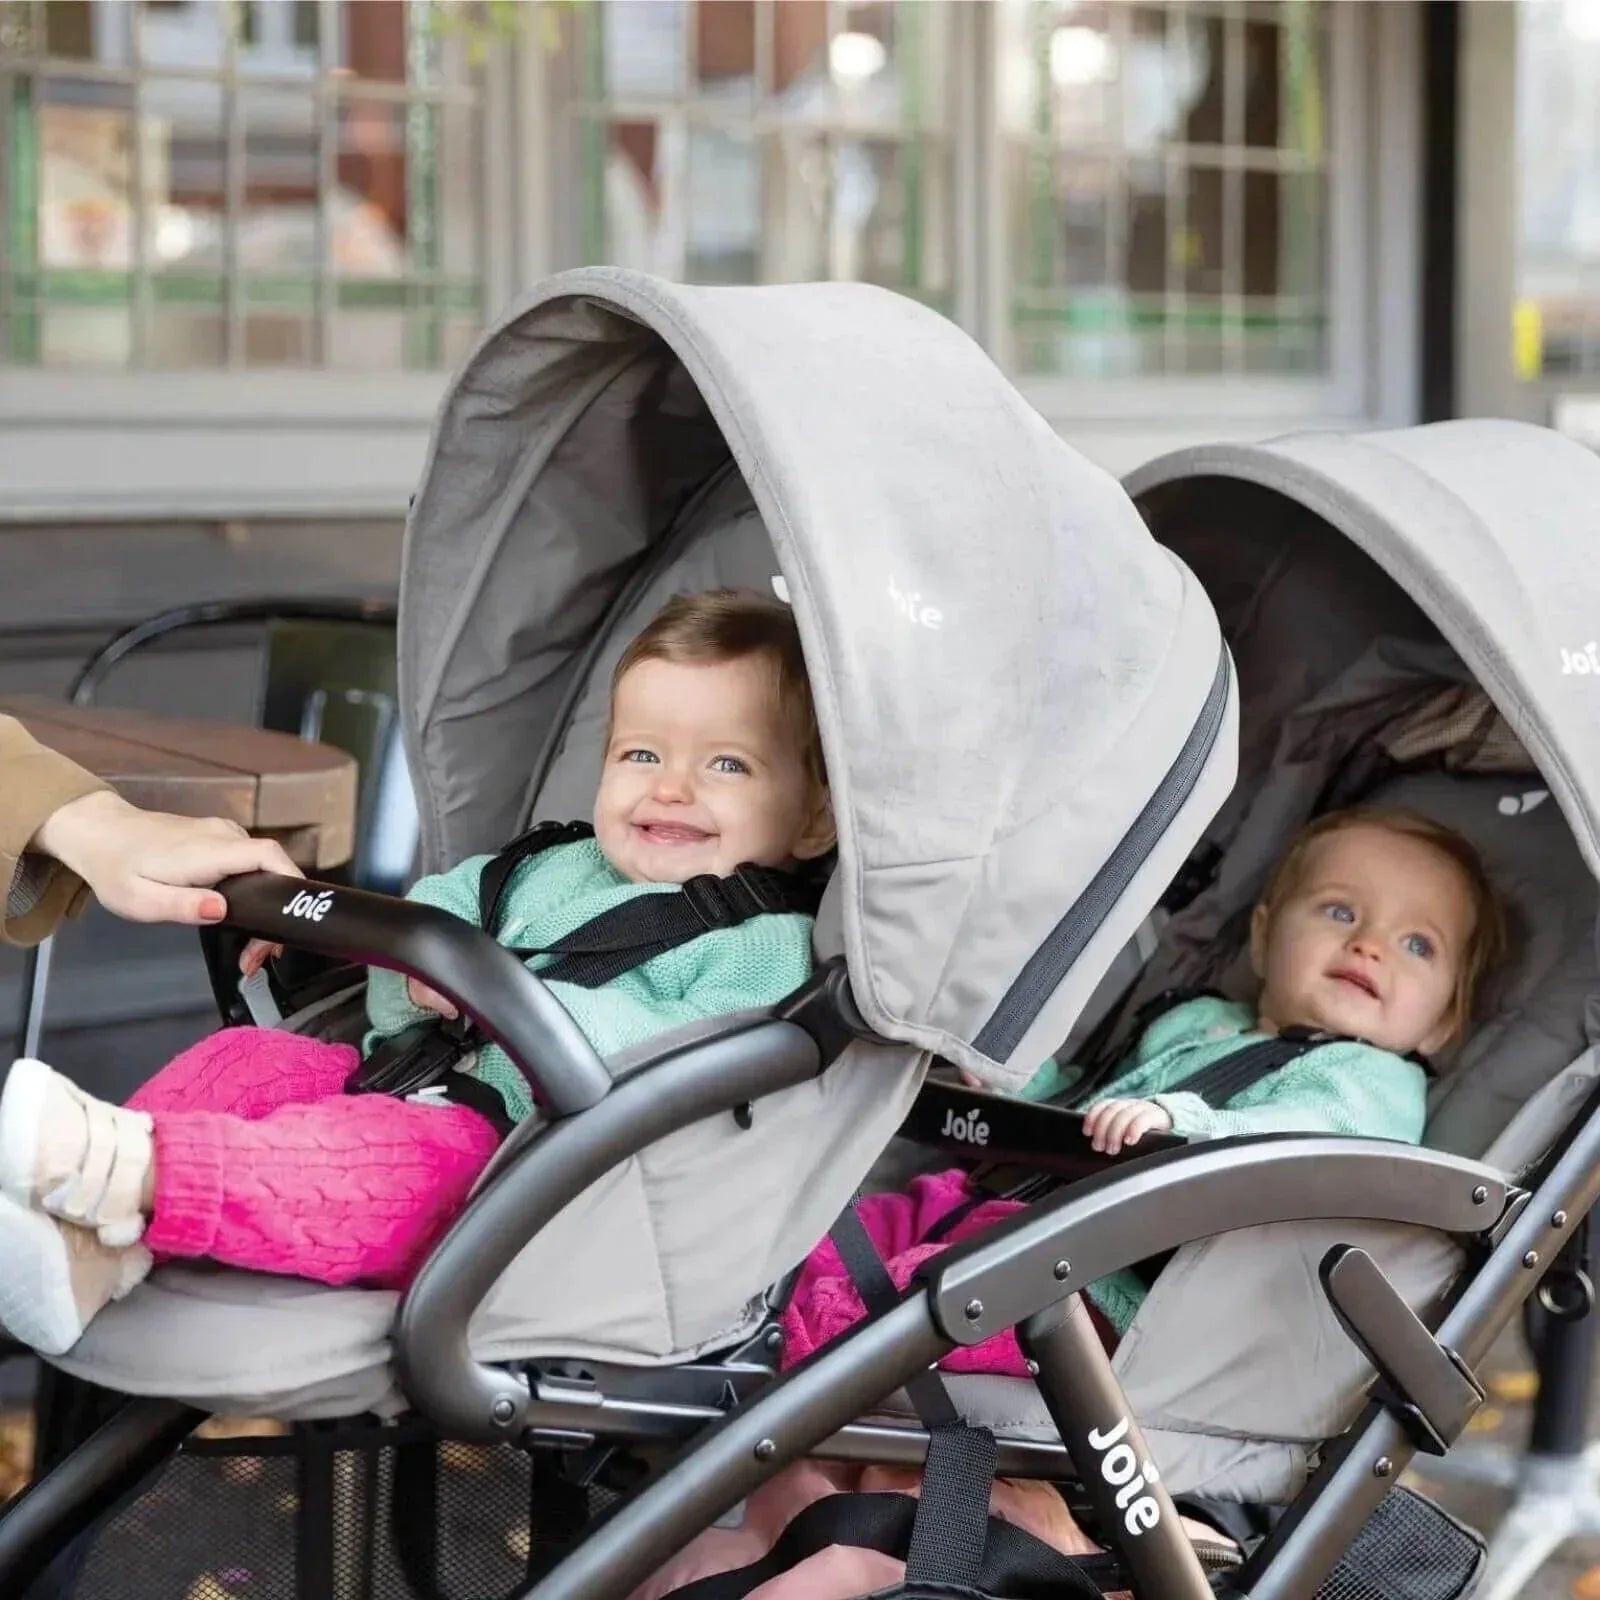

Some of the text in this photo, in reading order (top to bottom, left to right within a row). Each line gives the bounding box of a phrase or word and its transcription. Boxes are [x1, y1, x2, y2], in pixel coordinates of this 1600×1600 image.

[1560, 640, 1600, 675] Joi
[282, 890, 334, 922] Joie
[941, 1108, 990, 1146] Joie
[1088, 1416, 1160, 1536] Joie
